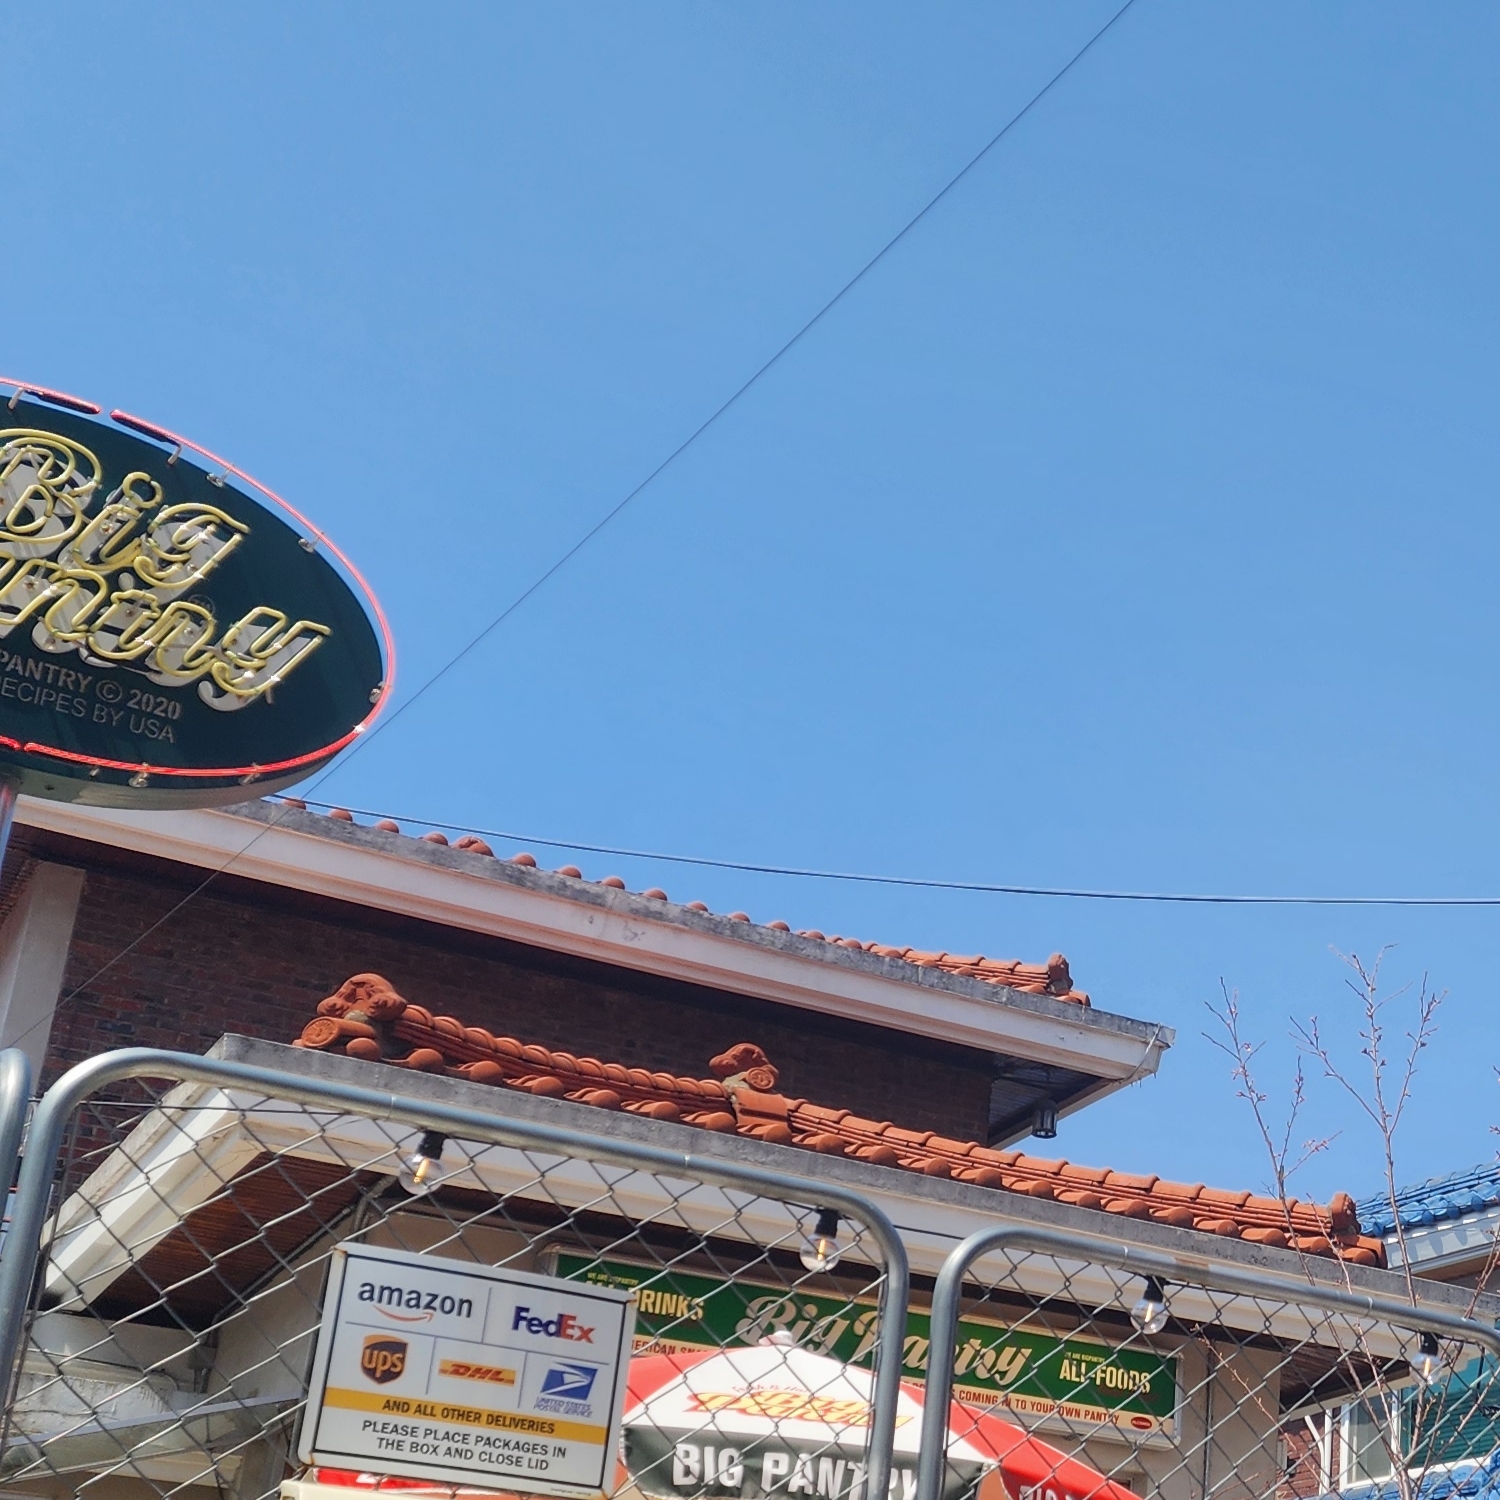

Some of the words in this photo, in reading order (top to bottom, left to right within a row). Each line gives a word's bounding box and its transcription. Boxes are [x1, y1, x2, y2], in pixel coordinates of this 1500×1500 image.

[0, 550, 333, 702] ntry
[0, 677, 87, 718] ECIPES
[93, 703, 124, 727] BY
[129, 714, 176, 744] USA
[127, 689, 182, 720] 2020
[357, 1282, 474, 1319] amazon
[511, 1306, 596, 1345] FedEx
[631, 1339, 677, 1356] ERICAN
[735, 1296, 850, 1355] Big
[853, 1310, 1033, 1386] Patry
[362, 1348, 404, 1379] ups
[449, 1362, 506, 1383] DHL
[382, 1399, 410, 1414] AND
[413, 1404, 437, 1418] ALL
[441, 1407, 481, 1424] OTHER
[485, 1413, 555, 1435] DELIVERIES
[959, 1390, 999, 1405] COMING
[1014, 1398, 1027, 1410] TO
[1030, 1401, 1056, 1414] YOUR
[1059, 1406, 1081, 1419] OWN
[362, 1419, 419, 1438] PLEASE
[423, 1429, 470, 1446] PLACE
[474, 1435, 549, 1456] PACKAGES
[552, 1446, 567, 1459] IN
[376, 1437, 405, 1452] THE
[409, 1442, 439, 1457] BOX
[443, 1446, 474, 1461] AND
[478, 1451, 523, 1468] CLOSE
[527, 1458, 549, 1471] LID
[672, 1442, 745, 1489] BIG
